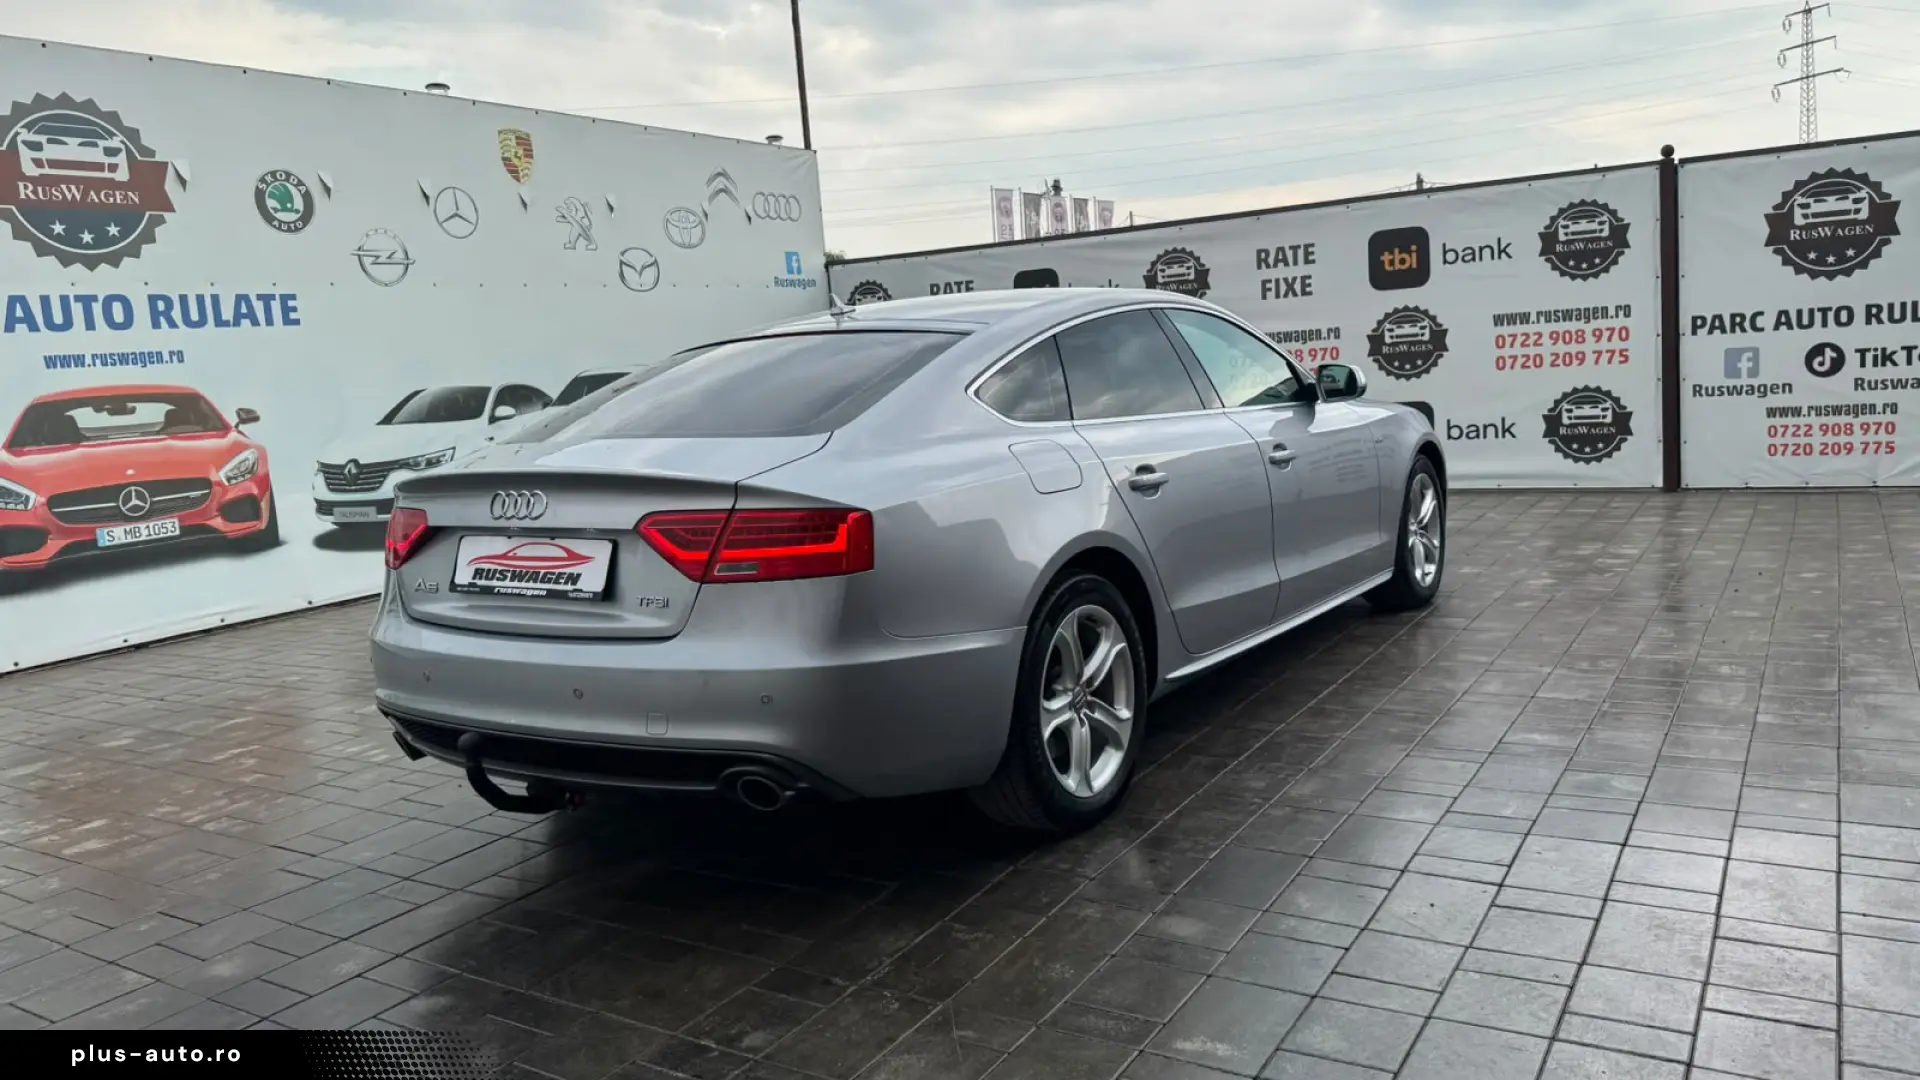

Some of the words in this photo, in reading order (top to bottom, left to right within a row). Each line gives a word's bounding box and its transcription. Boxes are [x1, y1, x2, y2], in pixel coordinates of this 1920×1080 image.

[272, 220, 303, 231] AUTO
[1256, 243, 1316, 270] RATE
[1380, 244, 1418, 271] tbi
[1442, 237, 1513, 266] bank
[773, 276, 816, 290] Ruswagen
[1261, 274, 1313, 301] FIXE
[3, 293, 135, 333] AUTO
[147, 293, 300, 329] RULATE
[1493, 304, 1632, 327] www.ruswagen.ro
[1691, 311, 1765, 336] PARC
[1773, 305, 1855, 331] AUTO
[1495, 331, 1544, 349] 0722
[1549, 329, 1586, 346] 908
[1591, 325, 1630, 344] 970
[43, 349, 185, 369] www.ruswagen.ro
[1308, 346, 1340, 362] 970
[1495, 353, 1544, 371] 0720
[1549, 350, 1586, 368] 209
[1591, 348, 1629, 365] 775
[1854, 345, 1920, 368] TikT
[1692, 382, 1793, 398] Ruswagen
[1766, 402, 1898, 418] www.ruswagen.ro
[1447, 416, 1516, 440] bank
[1767, 424, 1813, 438] 0722
[1819, 422, 1854, 437] 908
[1859, 421, 1896, 436] 970
[1767, 443, 1813, 456] 0720
[1819, 441, 1854, 456] 209
[1860, 440, 1895, 455] 775
[106, 530, 116, 543] S
[124, 526, 142, 540] MB
[145, 521, 177, 537] 1053
[472, 567, 582, 586] RUSWAGEN
[494, 587, 547, 596] ruswagen
